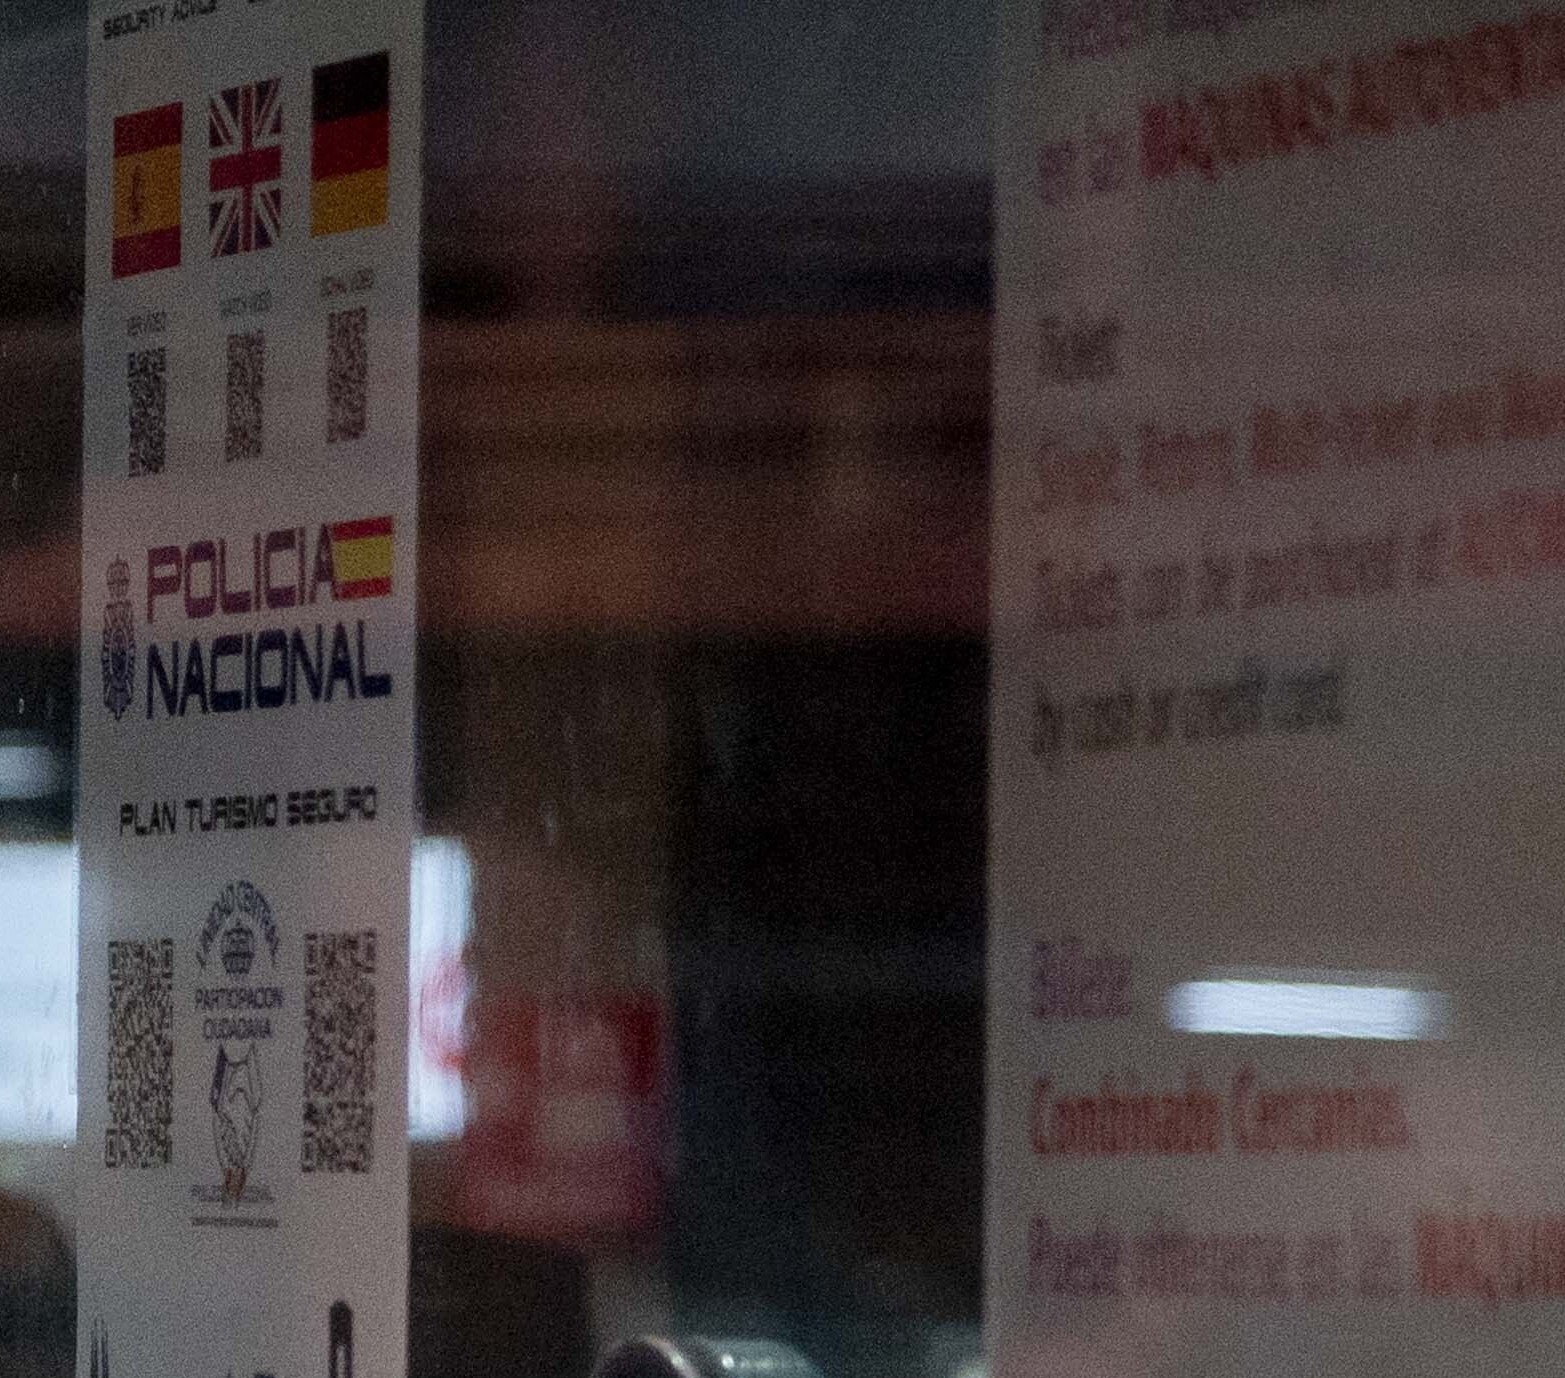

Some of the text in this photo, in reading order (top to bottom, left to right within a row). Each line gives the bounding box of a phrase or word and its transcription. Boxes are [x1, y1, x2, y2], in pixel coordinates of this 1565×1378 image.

[146, 523, 339, 625] POLICIA
[146, 620, 394, 720] NACIONAL
[118, 785, 379, 837] PLAN TURISMO SEGURO
